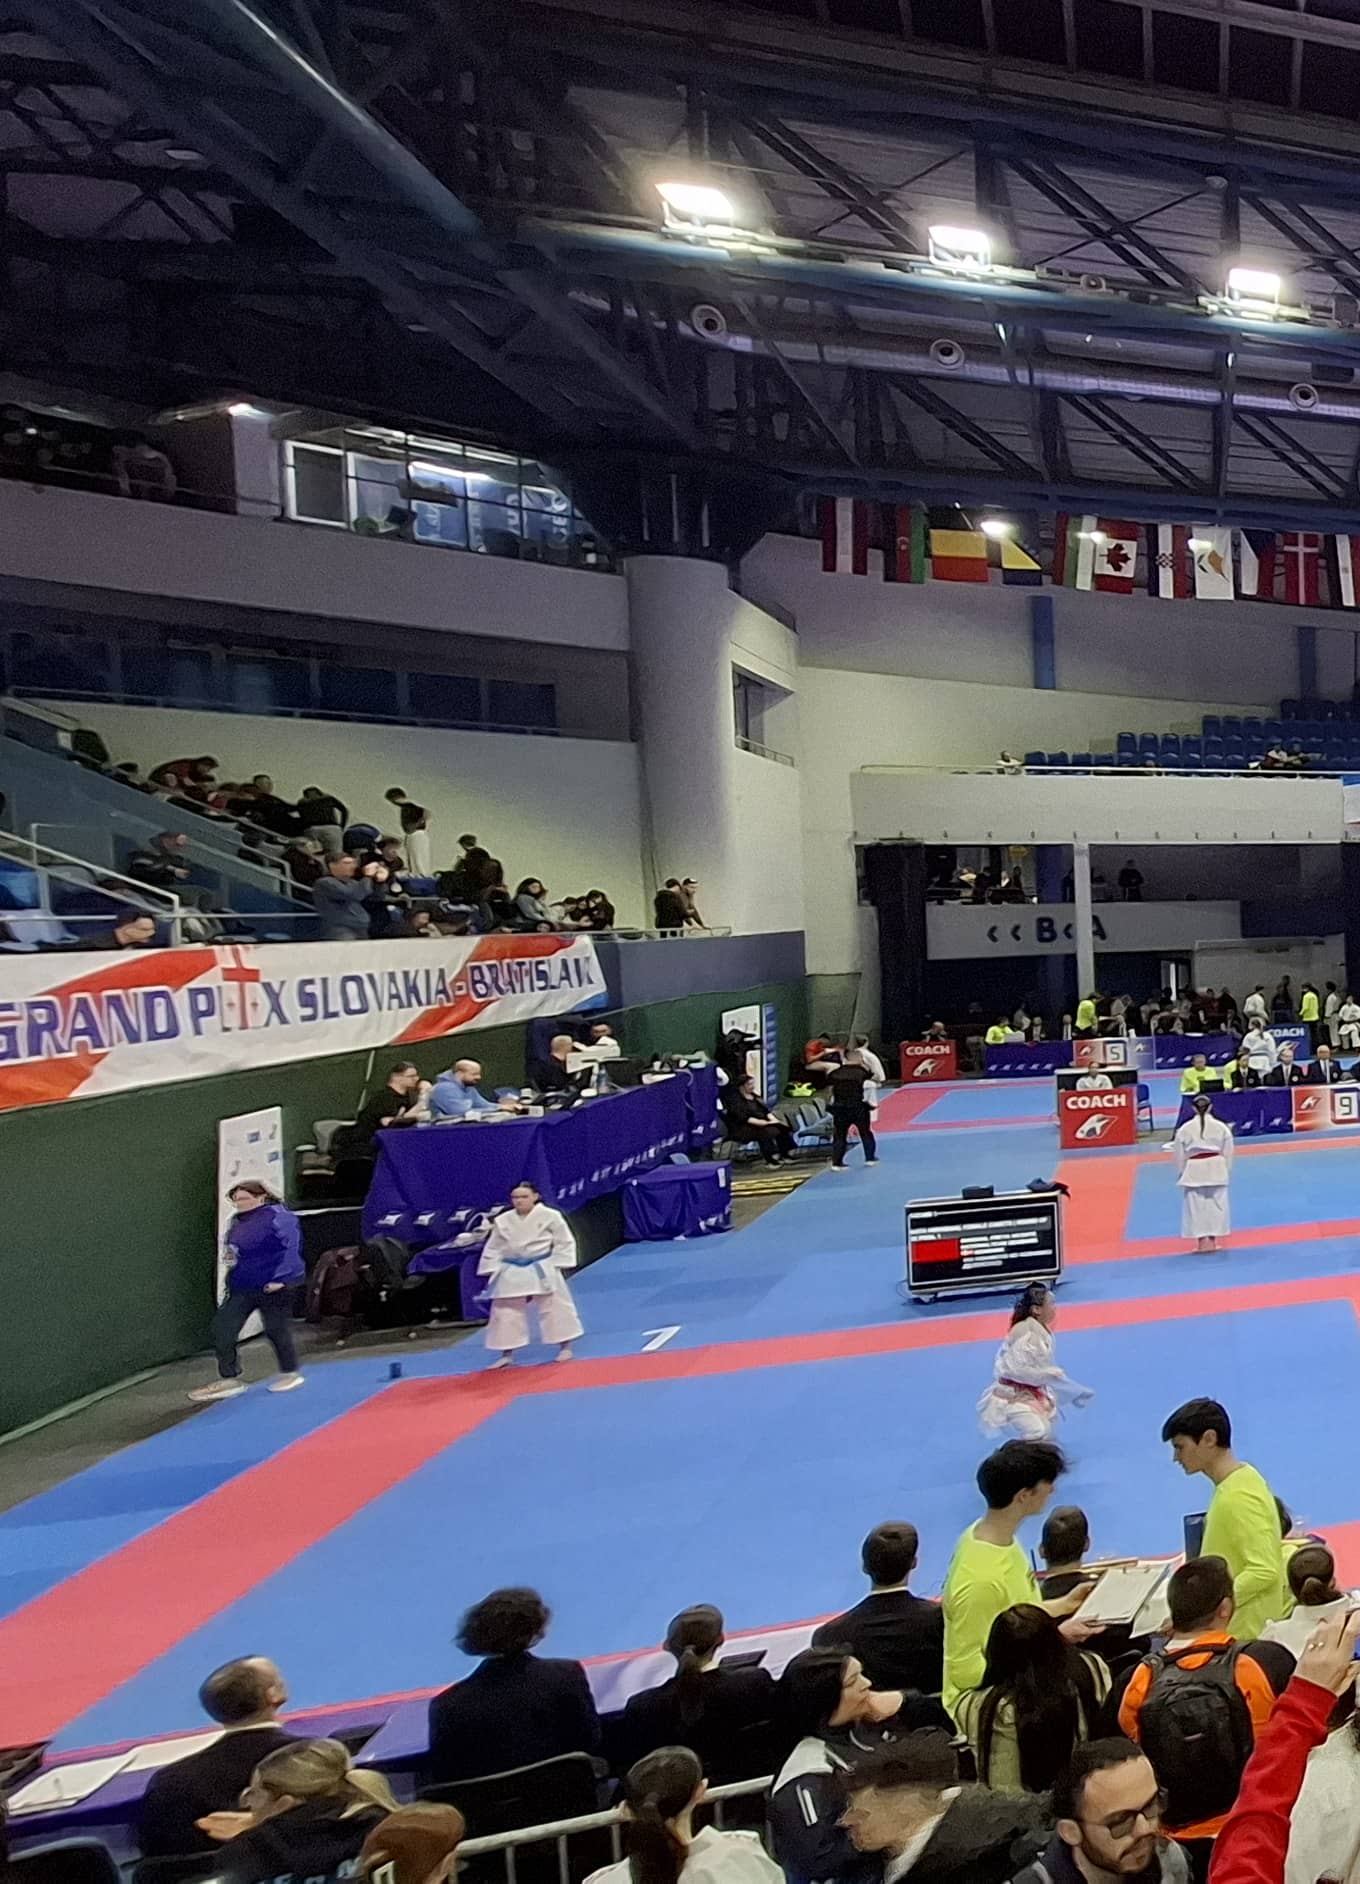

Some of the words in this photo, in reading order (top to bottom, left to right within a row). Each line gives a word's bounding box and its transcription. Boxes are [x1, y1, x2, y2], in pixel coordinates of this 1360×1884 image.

[1036, 916, 1058, 943] B
[905, 1044, 950, 1056] COACH
[1111, 1045, 1121, 1061] 5
[1066, 1094, 1127, 1110] COACH
[1340, 1095, 1353, 1116] 9
